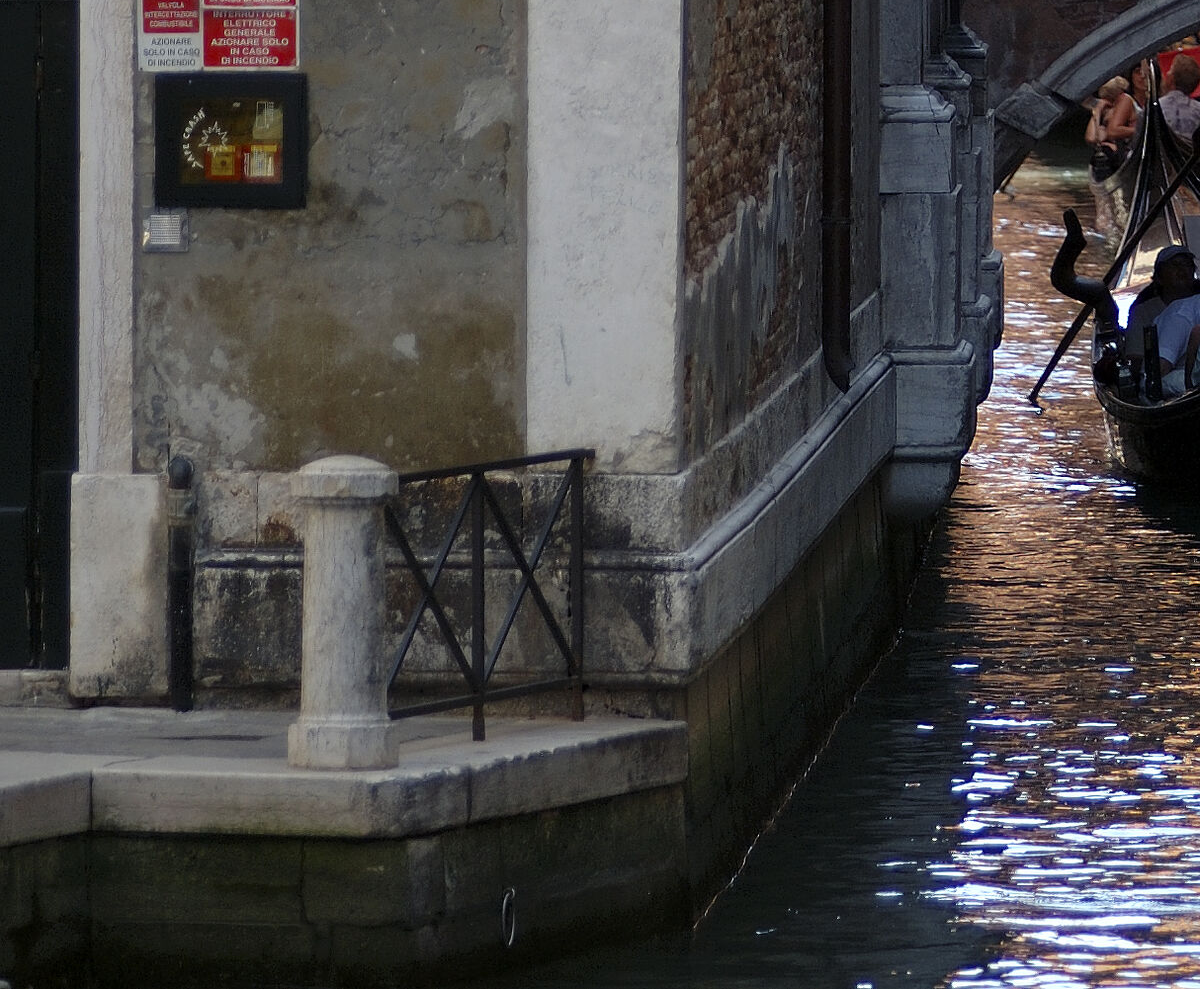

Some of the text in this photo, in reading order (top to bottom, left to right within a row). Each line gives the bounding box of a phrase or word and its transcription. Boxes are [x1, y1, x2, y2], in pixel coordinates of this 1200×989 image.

[212, 10, 286, 18] INTERRUTTORE
[223, 19, 277, 28] ELETTRICO
[223, 28, 276, 37] GENERALE
[150, 37, 192, 46] AZIONARE
[211, 38, 289, 46] AZIONARE SOLO
[143, 48, 200, 57] SOLO IN CASO
[230, 47, 270, 55] IN CASO
[147, 58, 196, 67] DI INCENDIO
[221, 56, 279, 65] DI INCENDIO
